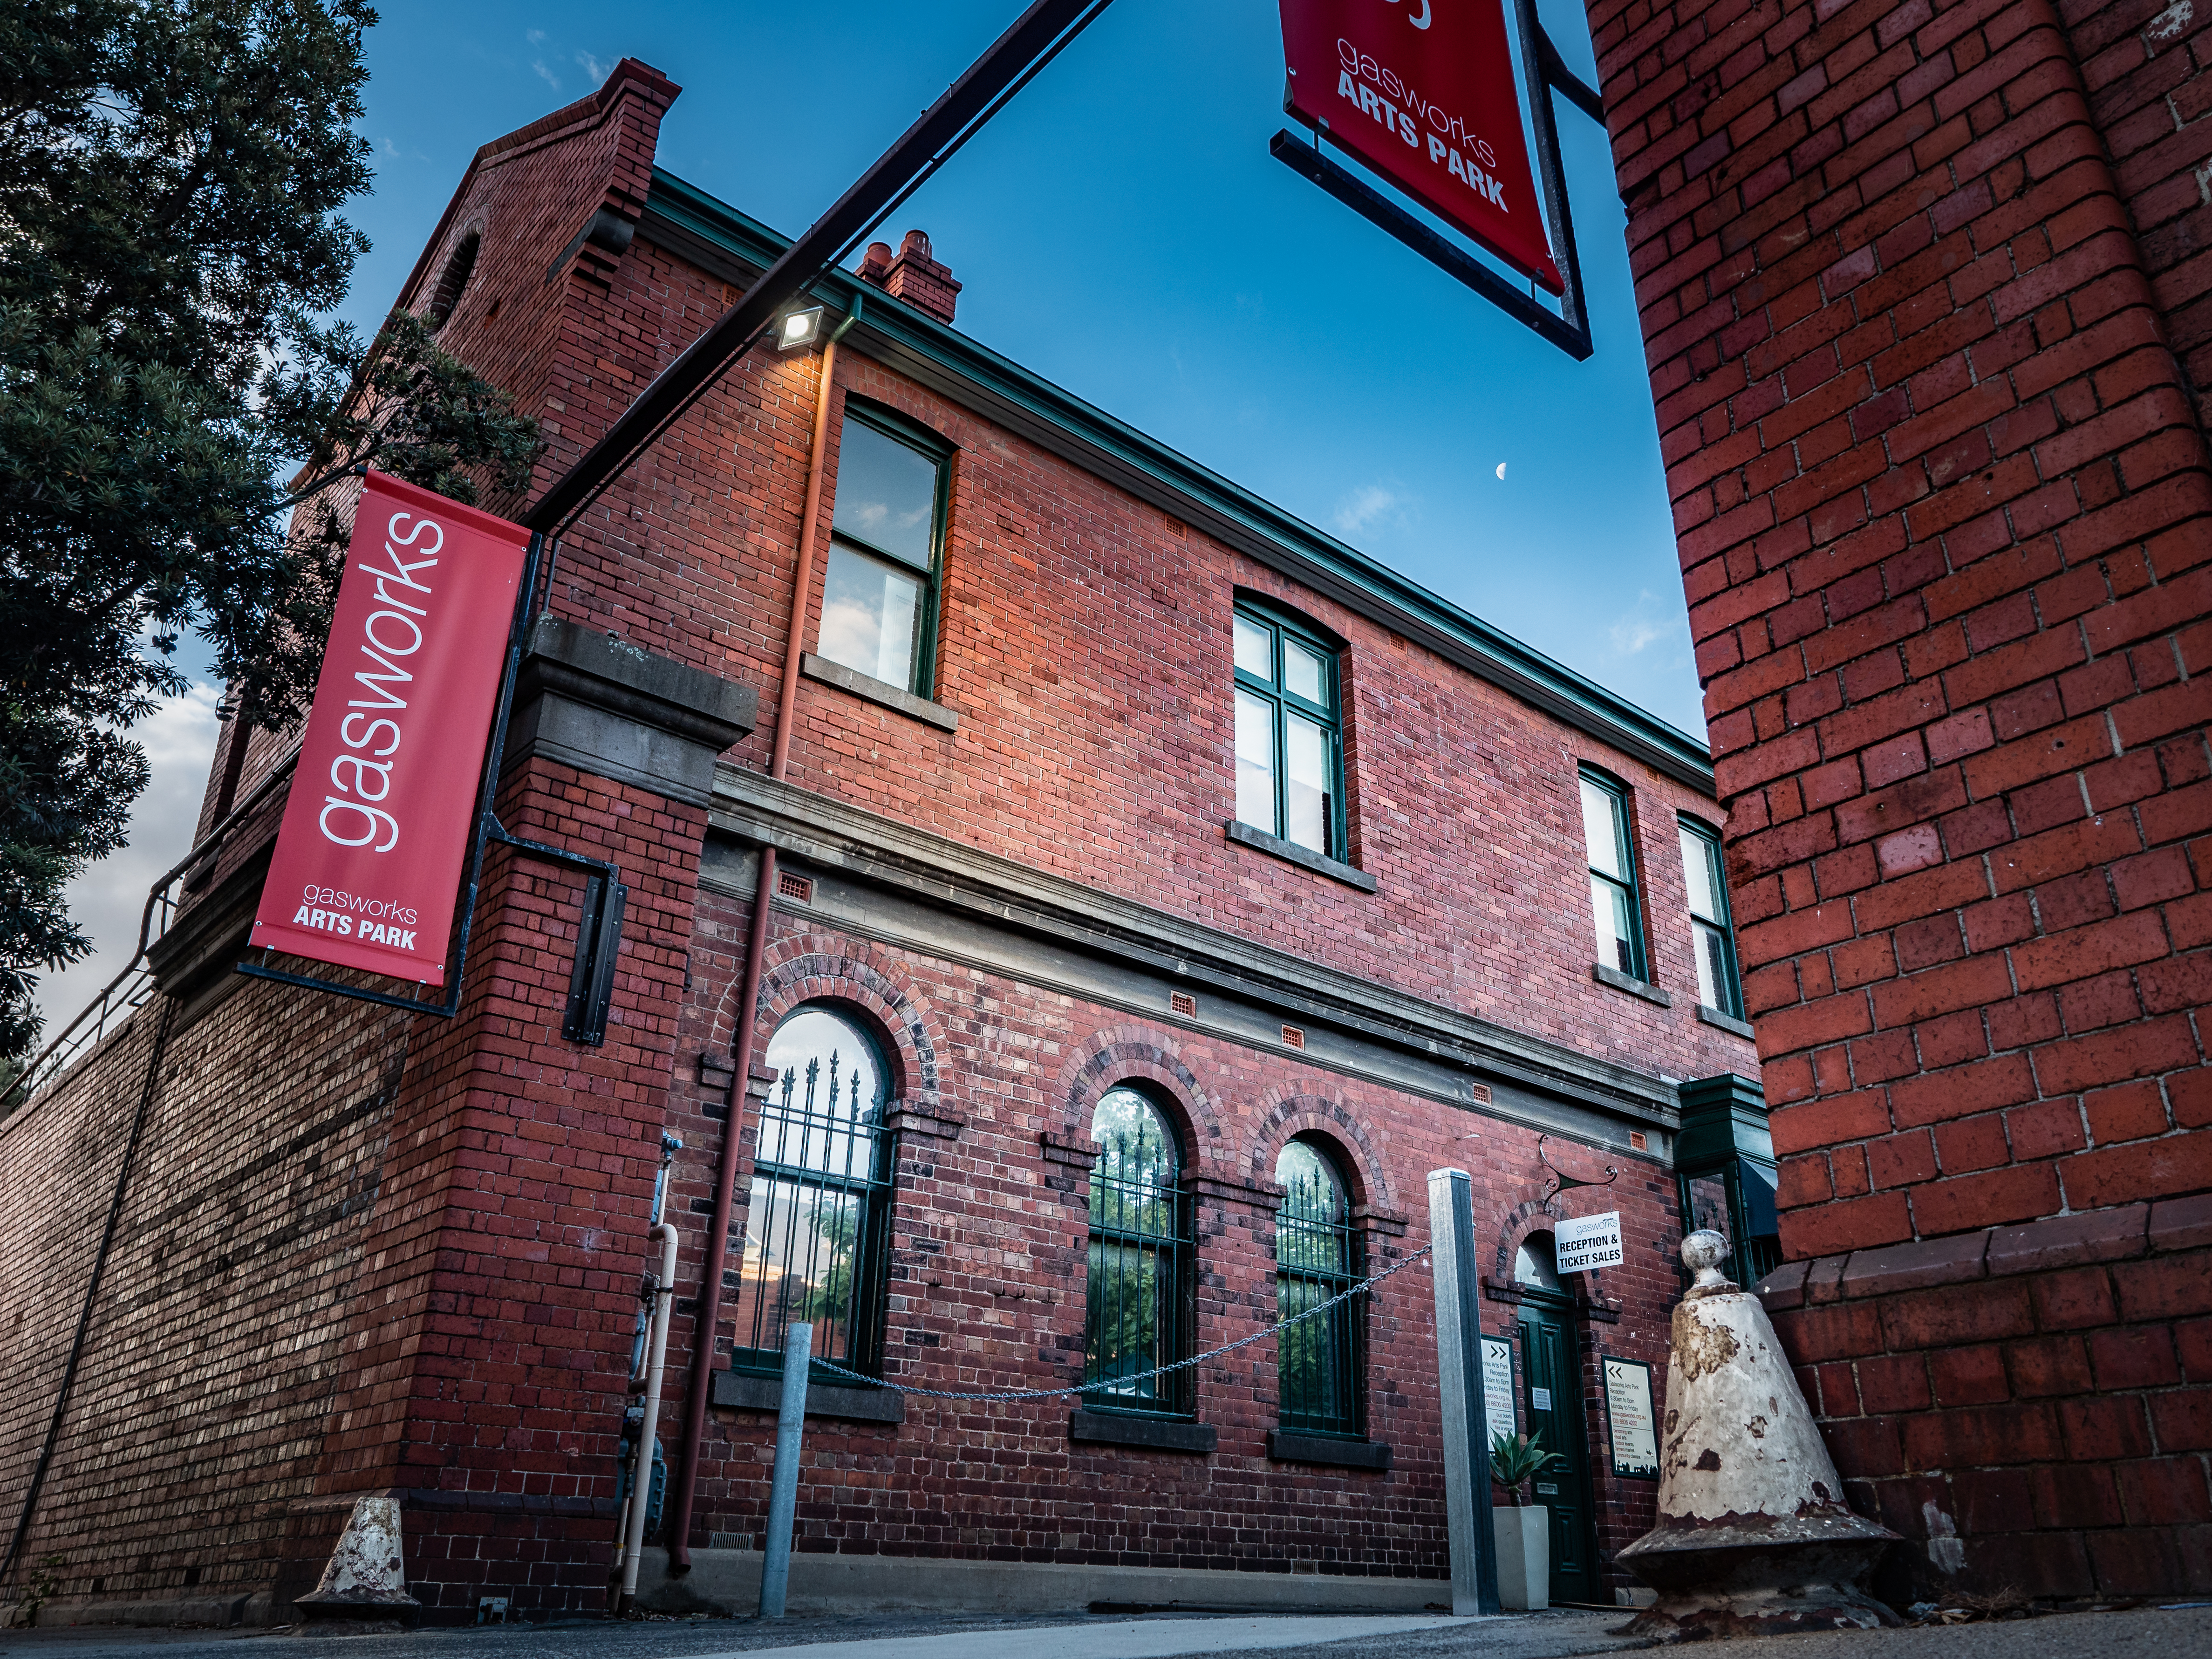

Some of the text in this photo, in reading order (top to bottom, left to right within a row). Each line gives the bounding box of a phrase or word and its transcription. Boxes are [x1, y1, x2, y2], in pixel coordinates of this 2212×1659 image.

[1338, 38, 1495, 168] gasworks
[1338, 70, 1509, 213] ARTS PARK
[319, 512, 444, 853] gasworks
[303, 884, 417, 924] gasworks
[293, 905, 417, 950] ARTS PARK
[1576, 1219, 1618, 1236] gasworks
[1559, 1234, 1618, 1253] RECEPTION &
[1559, 1249, 1620, 1268] TICKET SALES
[1490, 1369, 1509, 1377] Reception
[1609, 1380, 1625, 1388] Gasworks
[1485, 1393, 1511, 1401] sworks.org.au
[1611, 1412, 1646, 1420] www.gasworks.org.au
